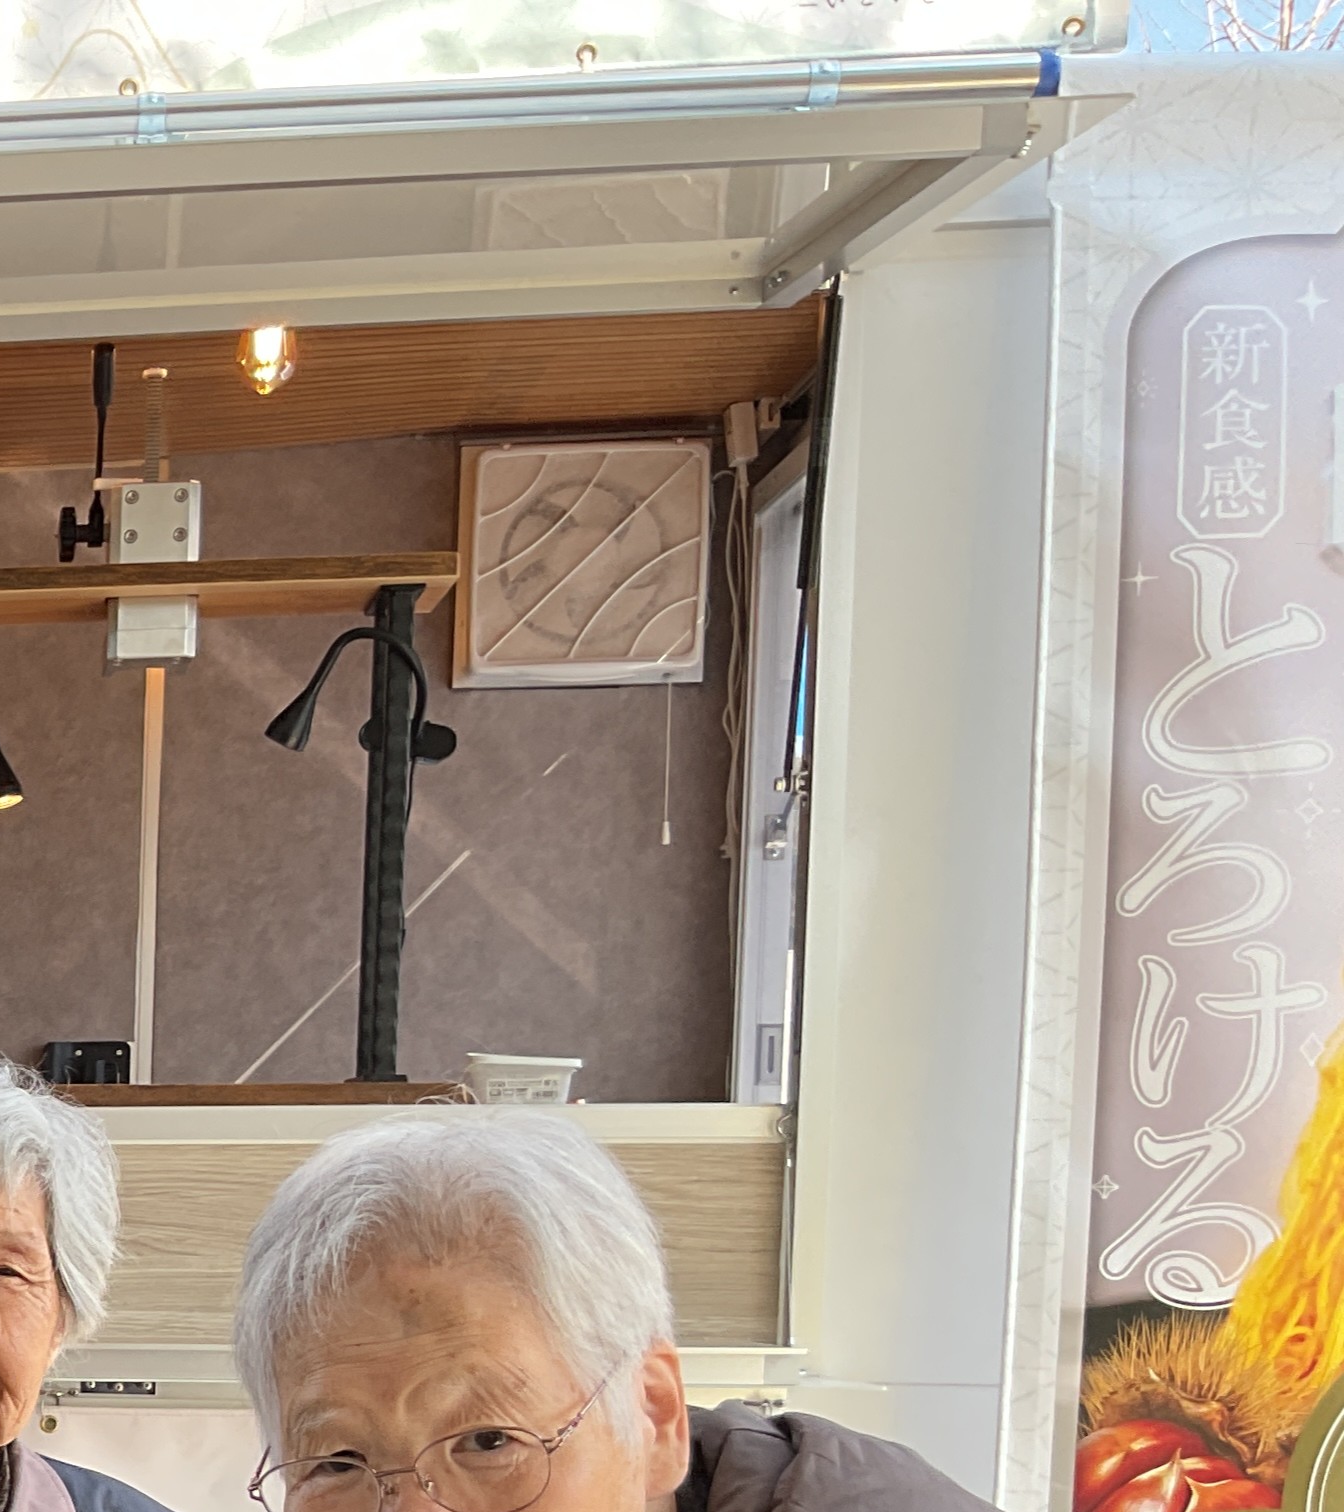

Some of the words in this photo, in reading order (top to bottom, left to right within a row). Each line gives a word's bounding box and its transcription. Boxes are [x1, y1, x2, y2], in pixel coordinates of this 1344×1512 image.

[1198, 322, 1270, 519] 新食感
[1099, 543, 1332, 1311] とろける
